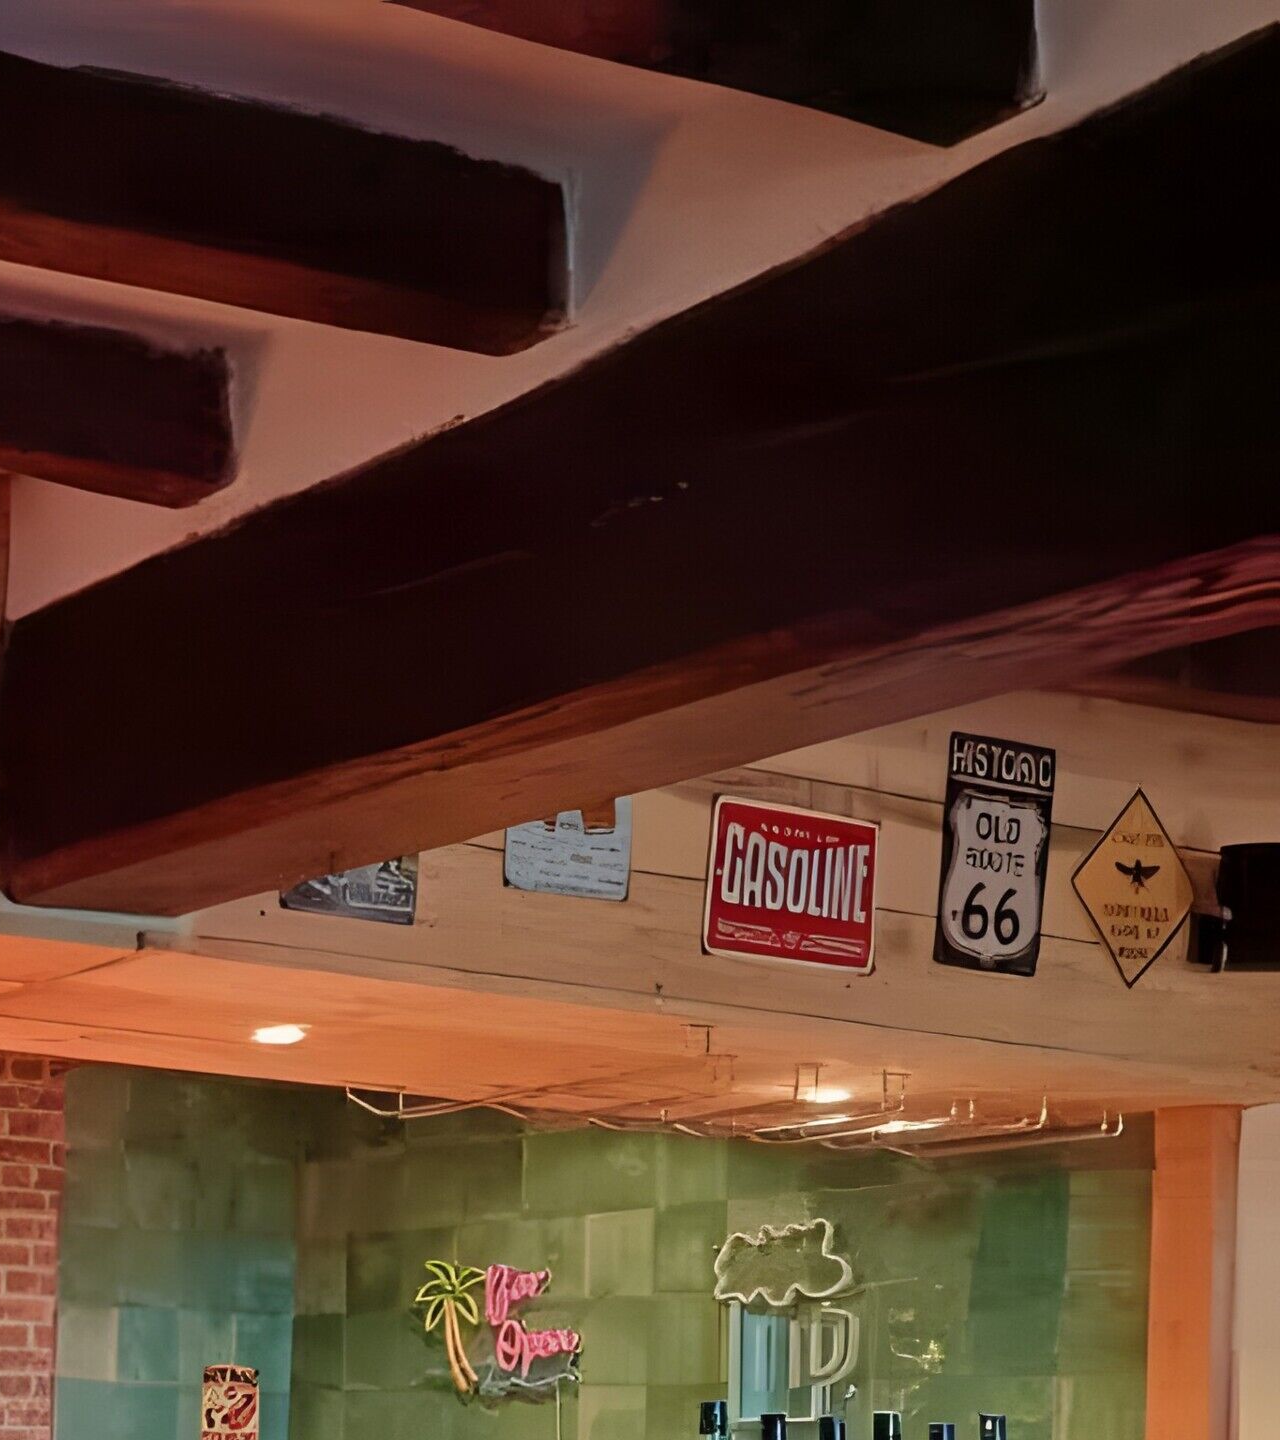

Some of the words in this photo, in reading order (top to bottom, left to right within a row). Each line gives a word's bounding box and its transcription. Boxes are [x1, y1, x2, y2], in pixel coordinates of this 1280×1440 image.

[975, 812, 1021, 845] OLD
[721, 822, 870, 923] GASOLINE
[961, 882, 1020, 946] 66
